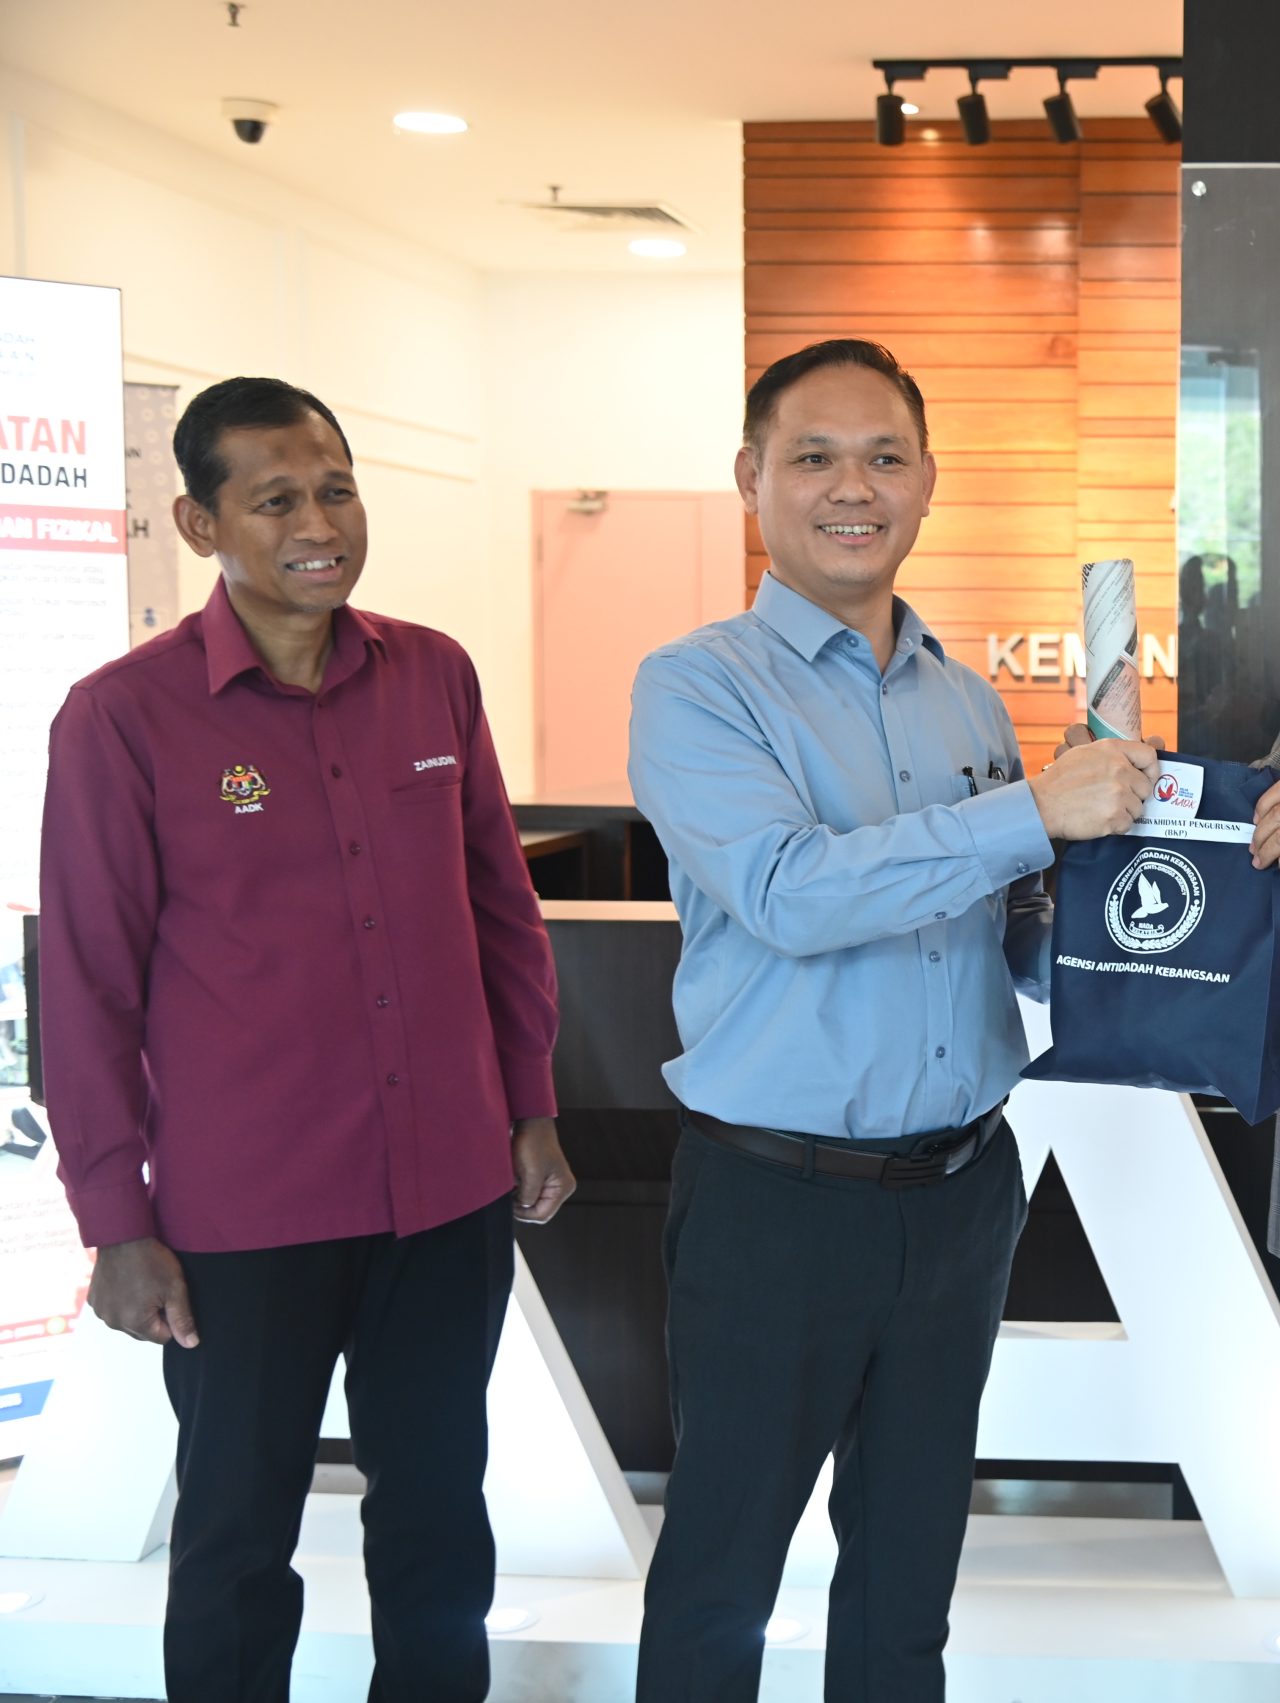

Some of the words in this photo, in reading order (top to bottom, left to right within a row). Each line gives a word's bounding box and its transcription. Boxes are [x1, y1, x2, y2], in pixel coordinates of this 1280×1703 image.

[1, 463, 87, 488] DADAH
[988, 633, 1178, 678] KEMN
[235, 802, 264, 815] AADK
[1153, 818, 1187, 828] KHIDMAT
[1189, 820, 1241, 832] PENGURUSAN
[1164, 829, 1188, 838] (BKP)
[1116, 867, 1135, 893] AGENSI
[1133, 851, 1170, 869] ANTIDADAH
[1170, 856, 1200, 897] KEBANGSAAN
[1056, 954, 1096, 971] AGENSI
[1096, 960, 1154, 975] ANTIDADAH
[1155, 965, 1231, 984] KEBANGSAAN
